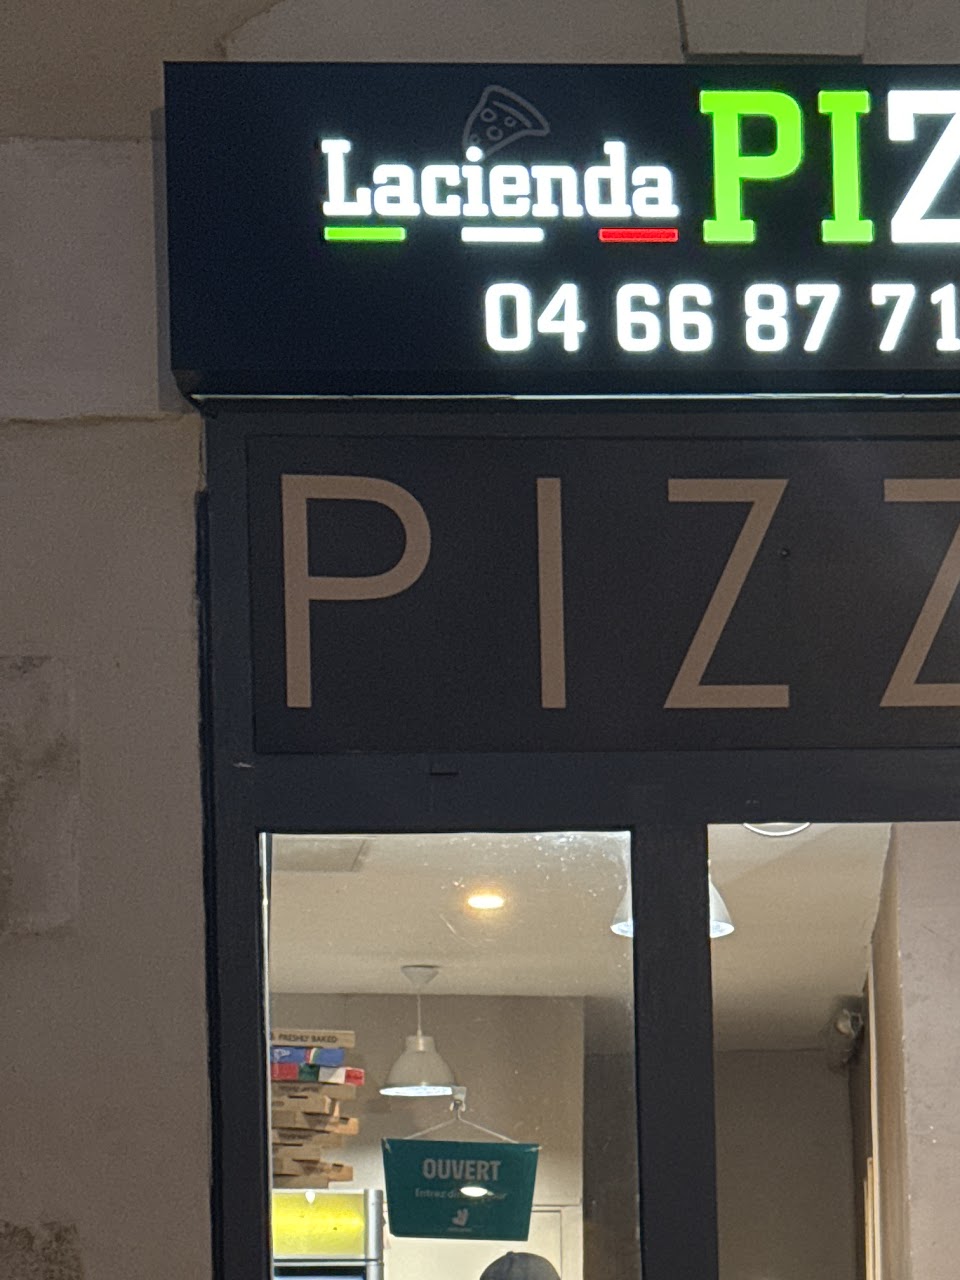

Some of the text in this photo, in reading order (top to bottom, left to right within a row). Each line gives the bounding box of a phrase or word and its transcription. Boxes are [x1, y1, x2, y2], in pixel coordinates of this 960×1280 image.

[321, 138, 680, 219] Lacienda
[484, 281, 586, 355] 04
[615, 281, 714, 355] 66
[742, 281, 838, 355] 87
[422, 1158, 502, 1181] OUVERT
